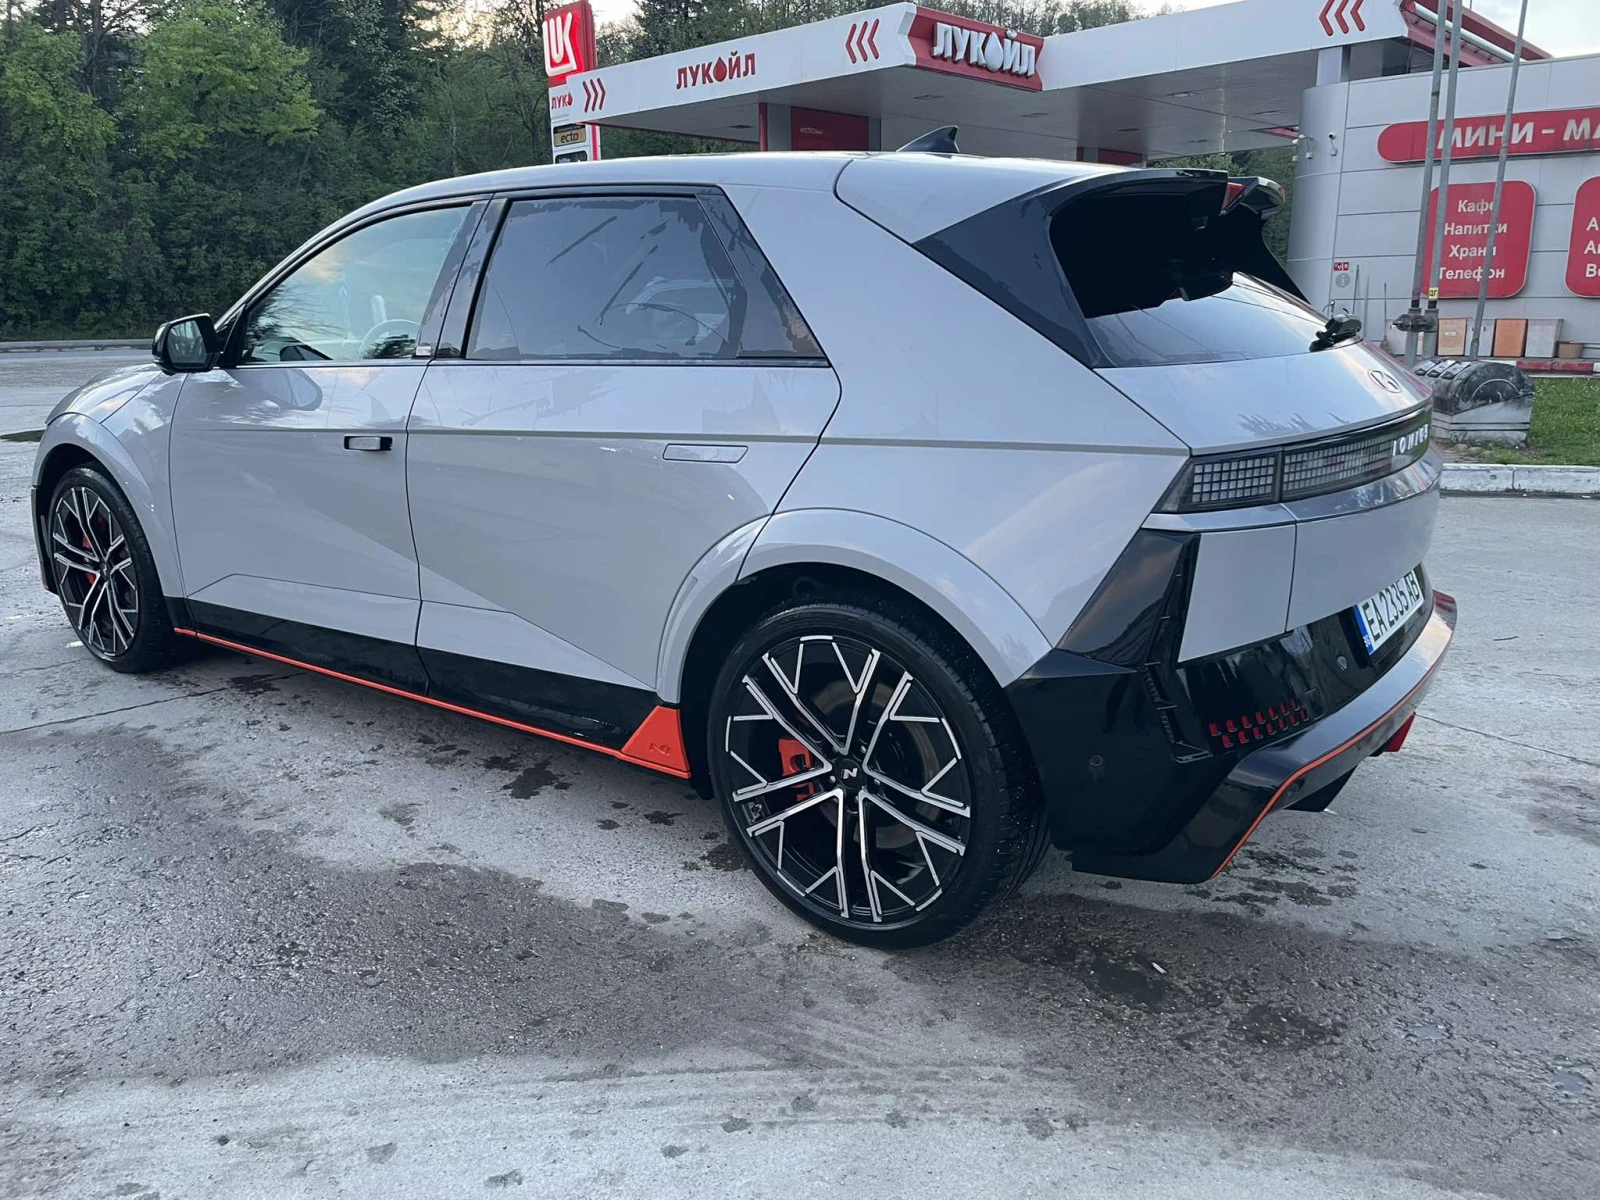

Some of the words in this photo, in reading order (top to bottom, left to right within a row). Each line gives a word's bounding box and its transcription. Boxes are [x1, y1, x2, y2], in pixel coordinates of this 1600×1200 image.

[933, 21, 1036, 77] ЛУКОЙЛ
[676, 50, 756, 90] ЛУКОЙЛ
[560, 131, 579, 143] ecto
[1437, 121, 1534, 149] МИНИ
[1444, 222, 1508, 236] Напити
[1584, 240, 1600, 254] А
[1585, 263, 1600, 277] В
[1362, 597, 1388, 643] EA
[1379, 579, 1409, 628] 2335
